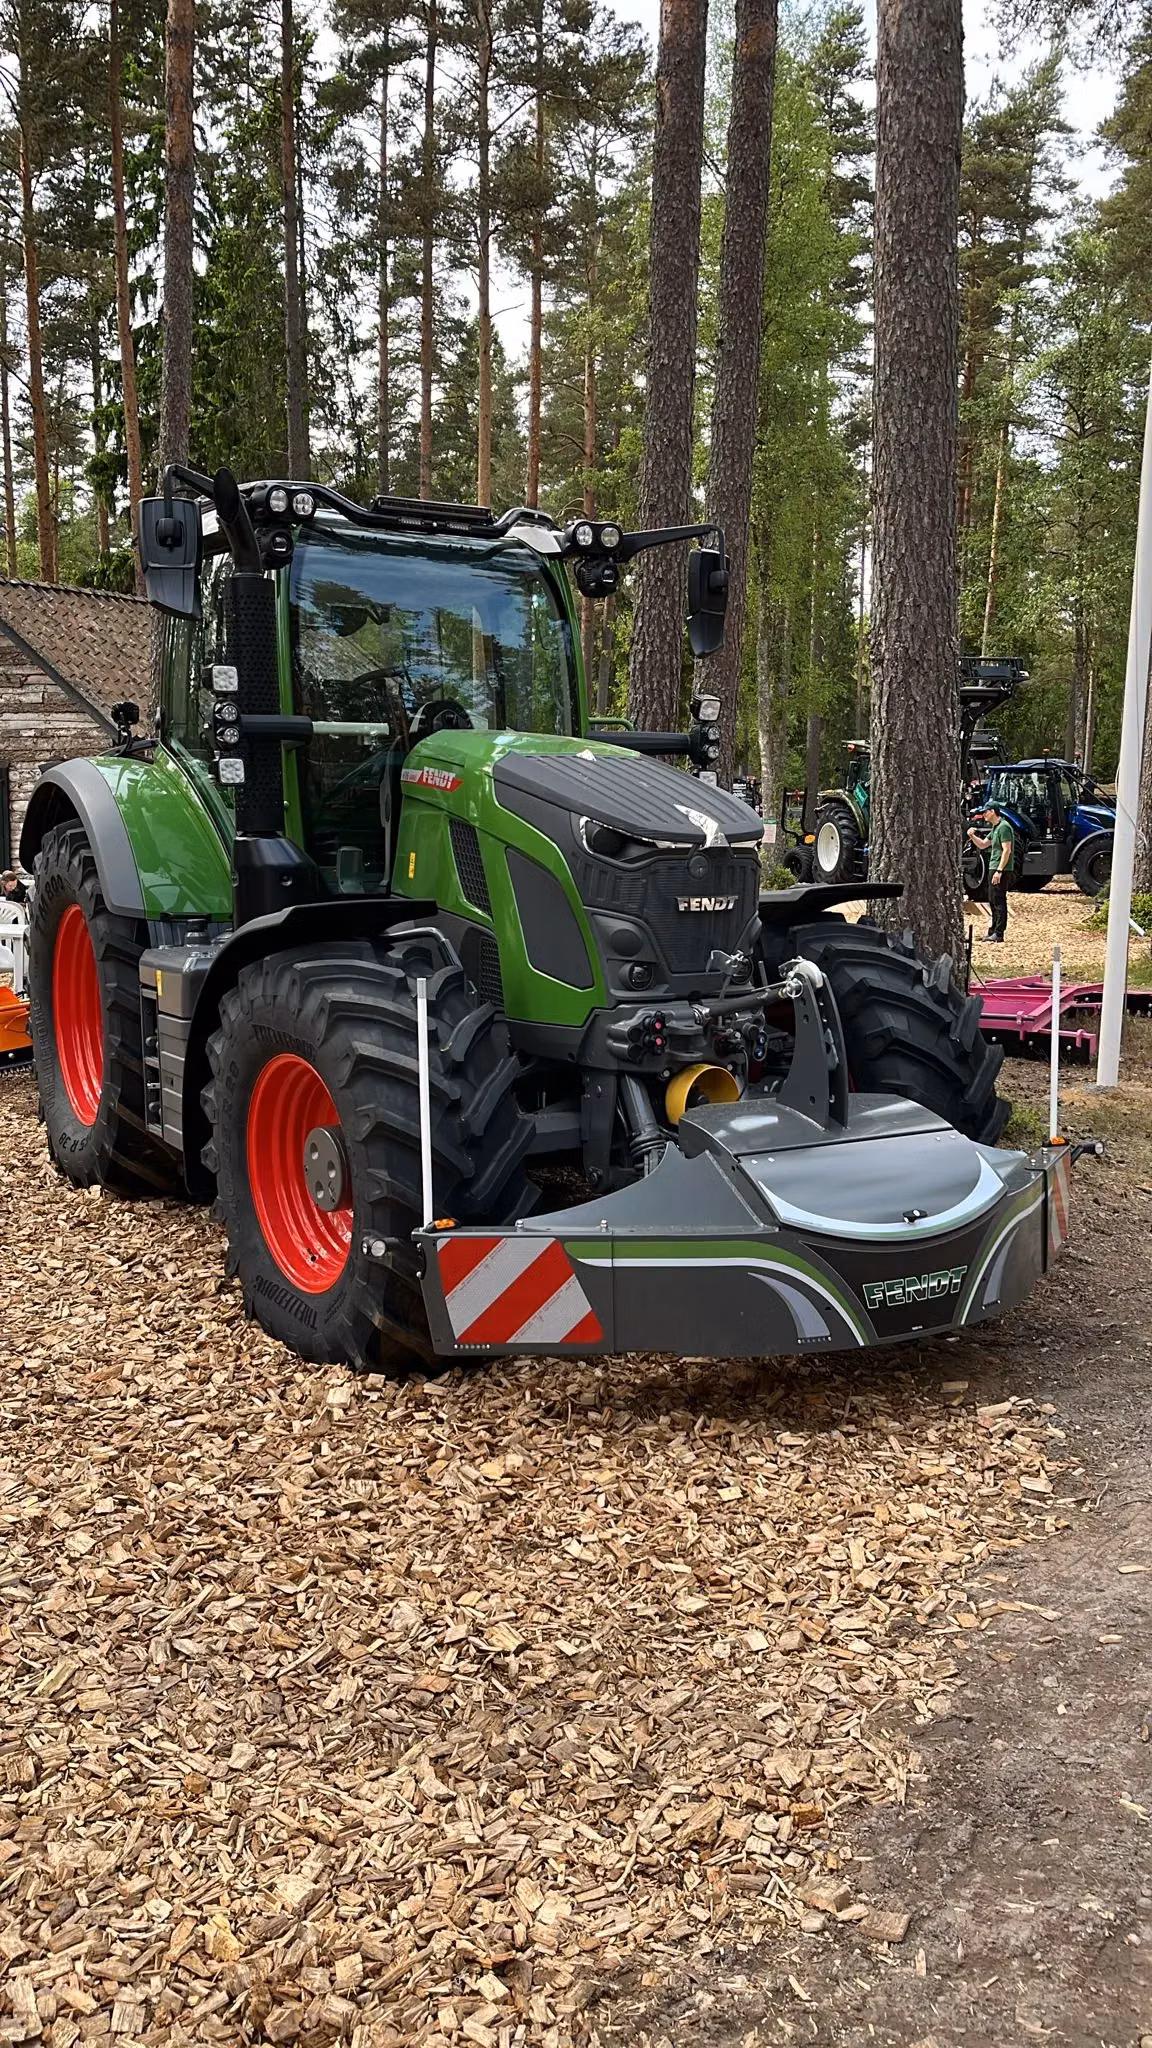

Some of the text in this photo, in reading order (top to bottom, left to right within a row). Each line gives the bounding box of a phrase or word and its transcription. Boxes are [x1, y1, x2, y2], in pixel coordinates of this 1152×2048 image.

[423, 766, 456, 789] FENDT
[676, 895, 739, 911] FENDT
[253, 1275, 318, 1331] TRELLEBORG
[862, 1265, 968, 1309] FENDT
